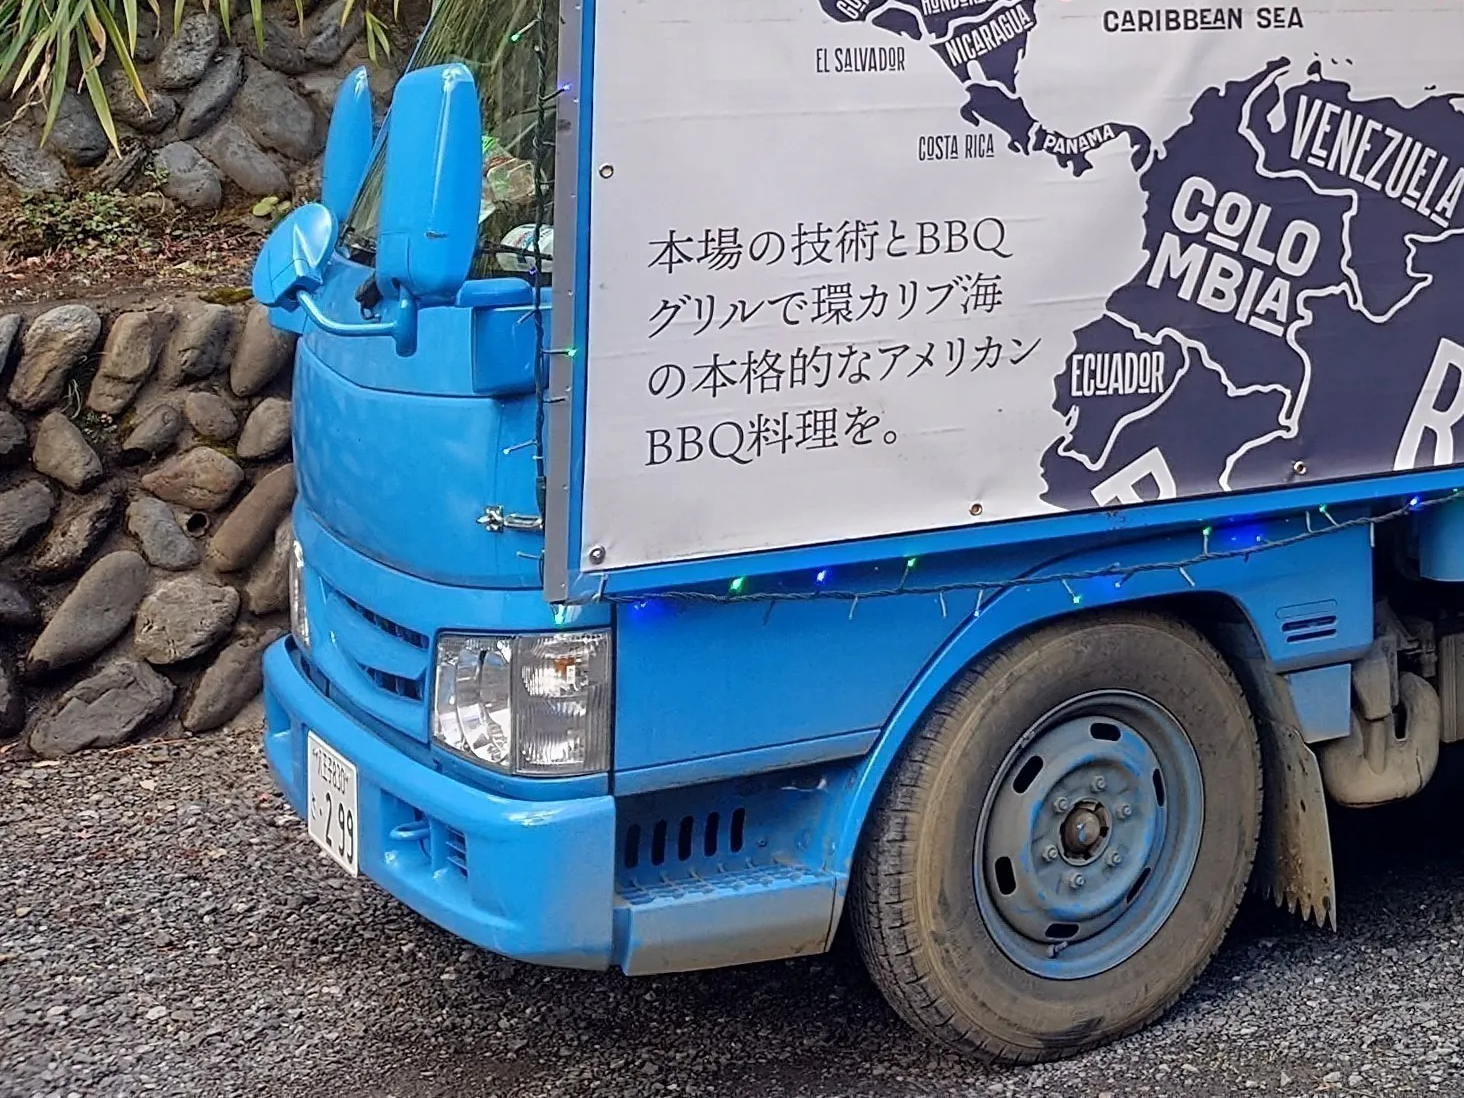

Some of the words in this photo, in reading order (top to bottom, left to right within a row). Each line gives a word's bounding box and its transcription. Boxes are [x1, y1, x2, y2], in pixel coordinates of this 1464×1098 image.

[944, 5, 1032, 68] NICARAGUA
[1103, 7, 1243, 33] CARIBBEAN
[1256, 7, 1304, 30] SEA
[816, 49, 831, 73] EL
[834, 46, 906, 73] SALVADOR
[918, 134, 959, 161] COSTA
[964, 133, 995, 158] RICA
[1043, 123, 1115, 155] PANAMA
[647, 216, 1013, 274] 本場の技術とBBQ
[1172, 176, 1320, 277] COLO
[648, 272, 1003, 339] グリルで環カリブ海
[1147, 232, 1290, 337] MBIA
[649, 335, 1042, 401] の本格的なアメリカン
[1070, 350, 1165, 396] ECUADOR
[645, 405, 898, 467] BBQ料理を。
